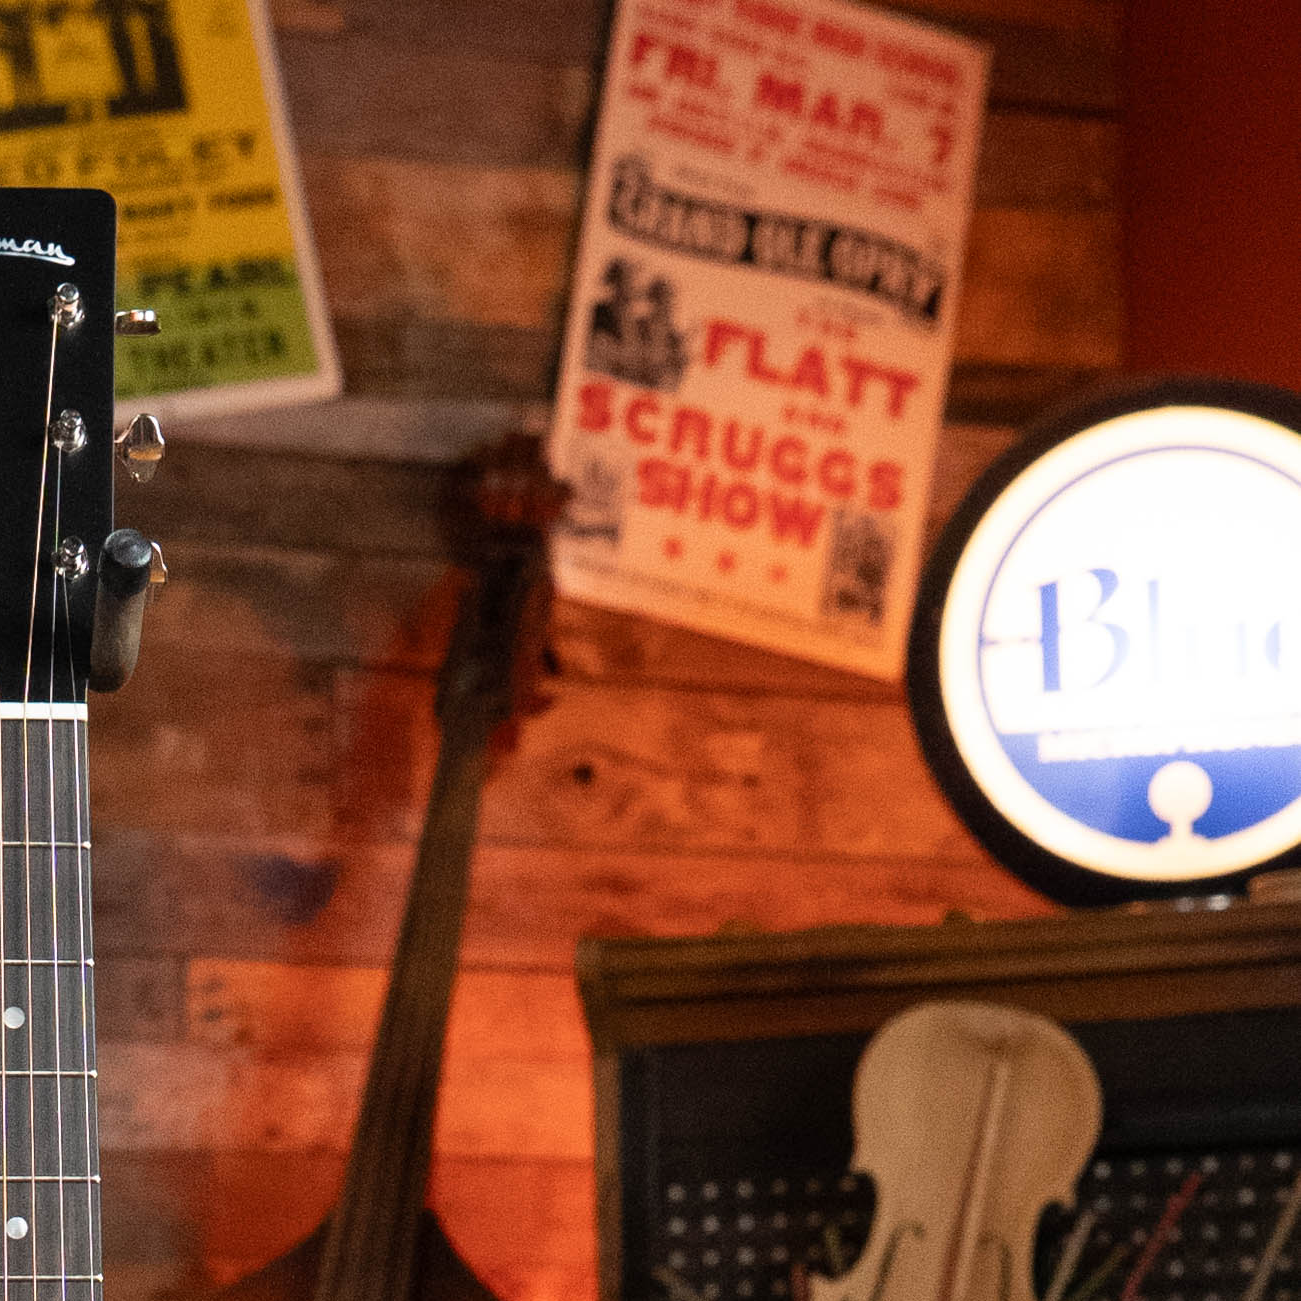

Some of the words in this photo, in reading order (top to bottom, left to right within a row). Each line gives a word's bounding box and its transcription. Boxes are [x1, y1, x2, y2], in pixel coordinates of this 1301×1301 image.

[702, 319, 920, 420] FLATT
[577, 382, 905, 512] SCRUGGS
[636, 456, 826, 548] SHOW
